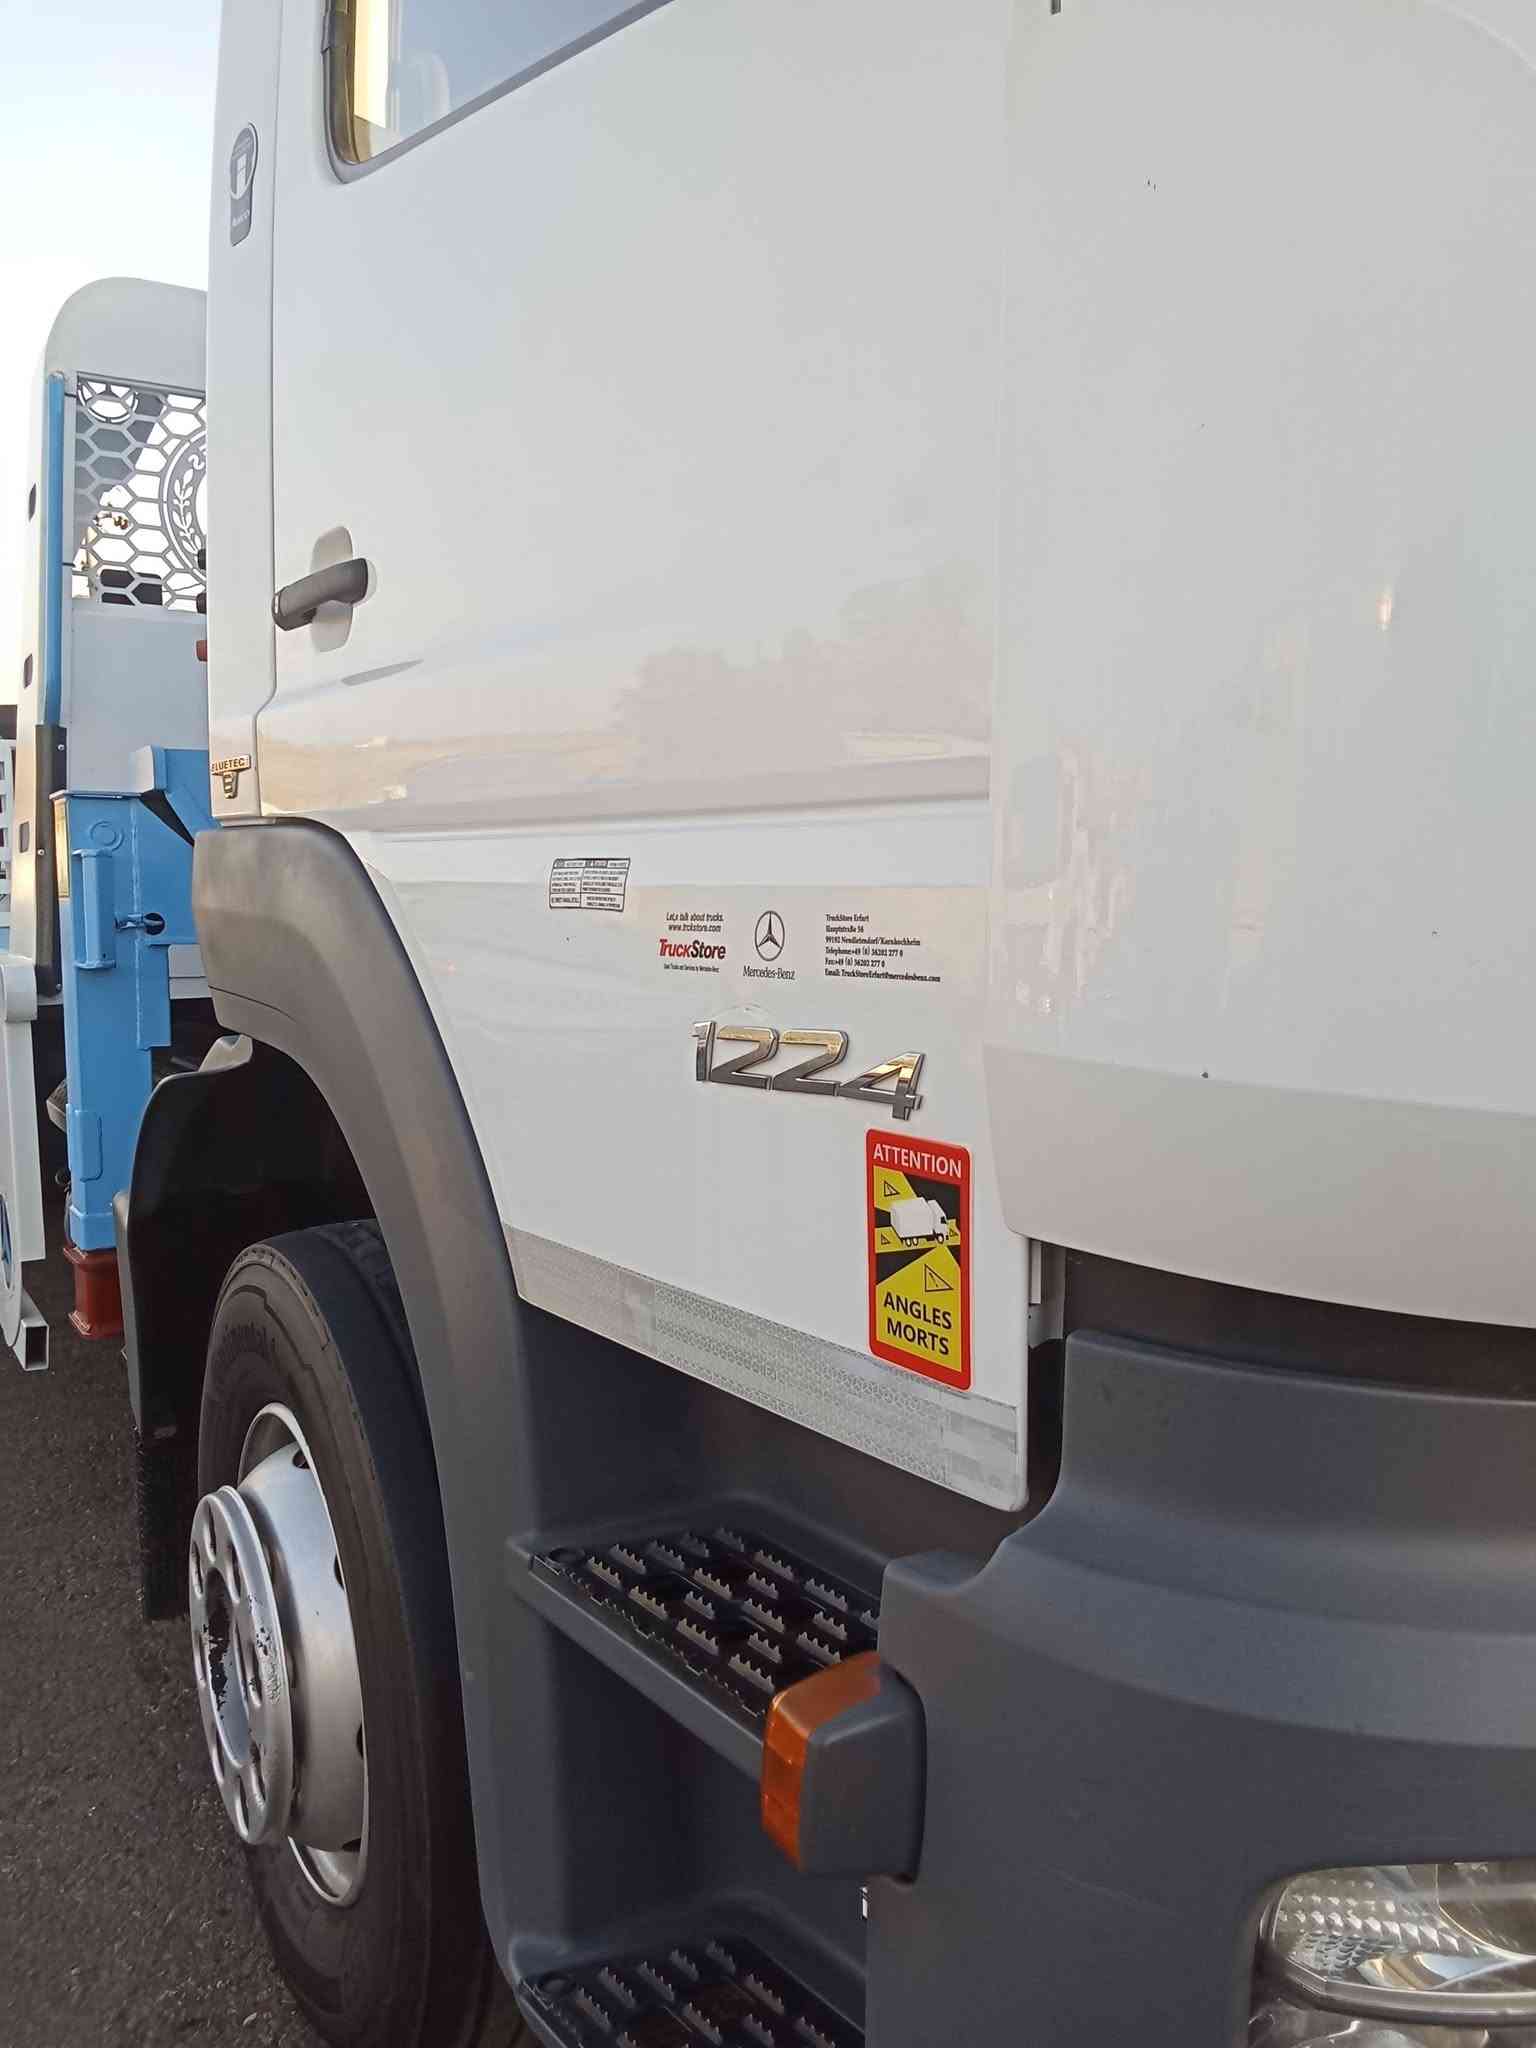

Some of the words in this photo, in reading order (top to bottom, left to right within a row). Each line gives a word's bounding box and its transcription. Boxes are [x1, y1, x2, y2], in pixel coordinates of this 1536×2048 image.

[659, 938, 726, 960] TruckStore
[743, 965, 796, 981] Mercedes-Benz
[692, 1020, 926, 1121] 1224
[872, 1143, 962, 1178] ATTENTION
[883, 1291, 952, 1330] ANGLES
[886, 1317, 949, 1355] MORTS
